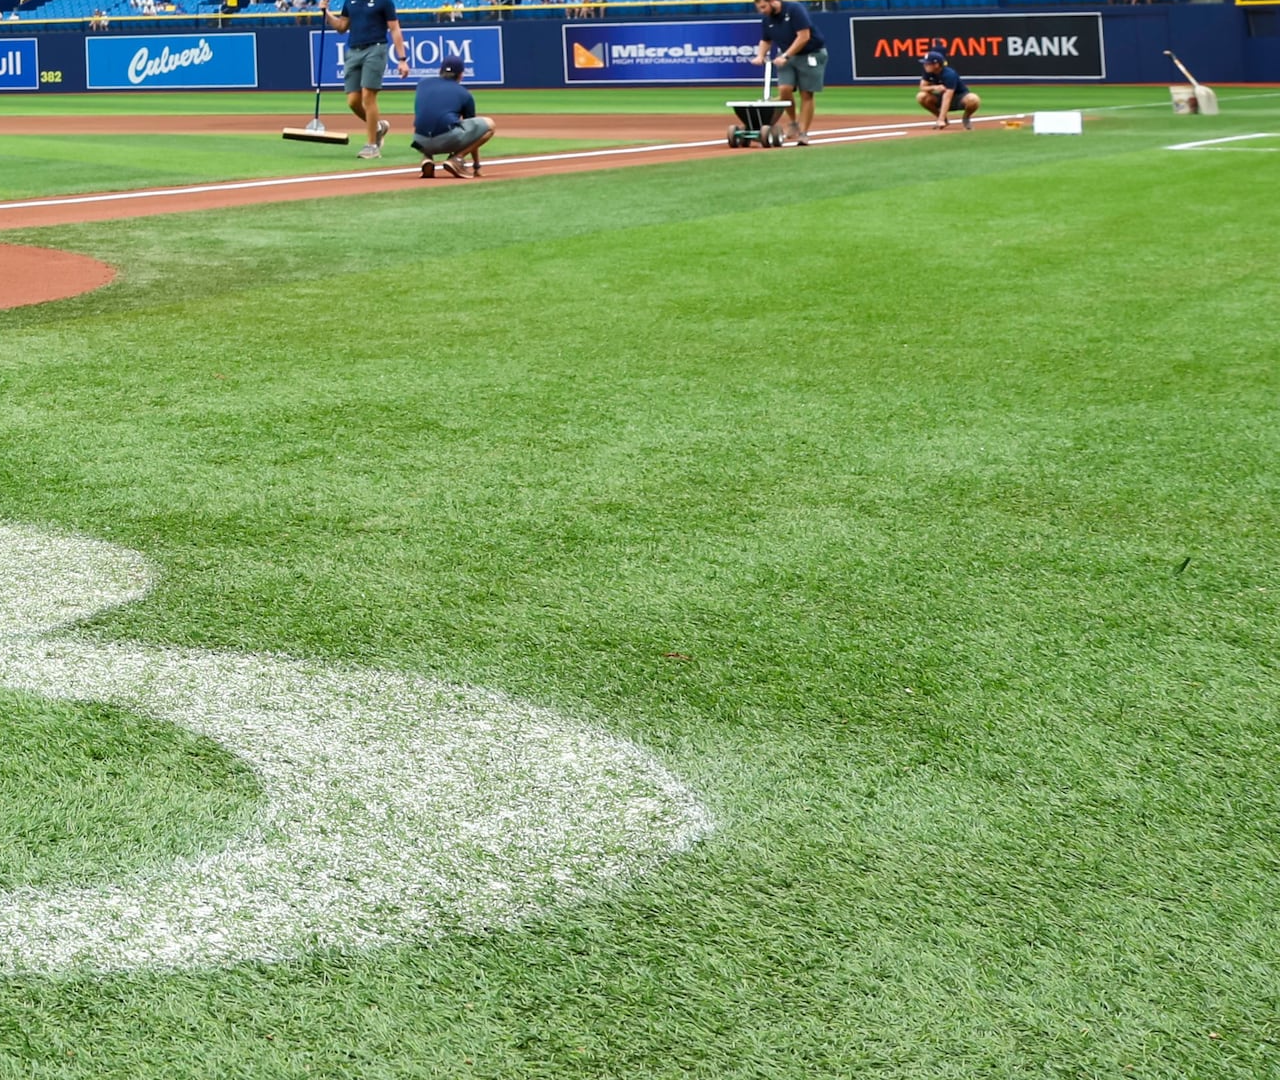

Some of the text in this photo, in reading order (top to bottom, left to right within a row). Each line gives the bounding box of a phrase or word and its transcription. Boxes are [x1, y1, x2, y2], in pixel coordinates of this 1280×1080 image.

[1007, 36, 1079, 56] BANK
[128, 38, 213, 84] Culver's
[40, 71, 62, 83] 382
